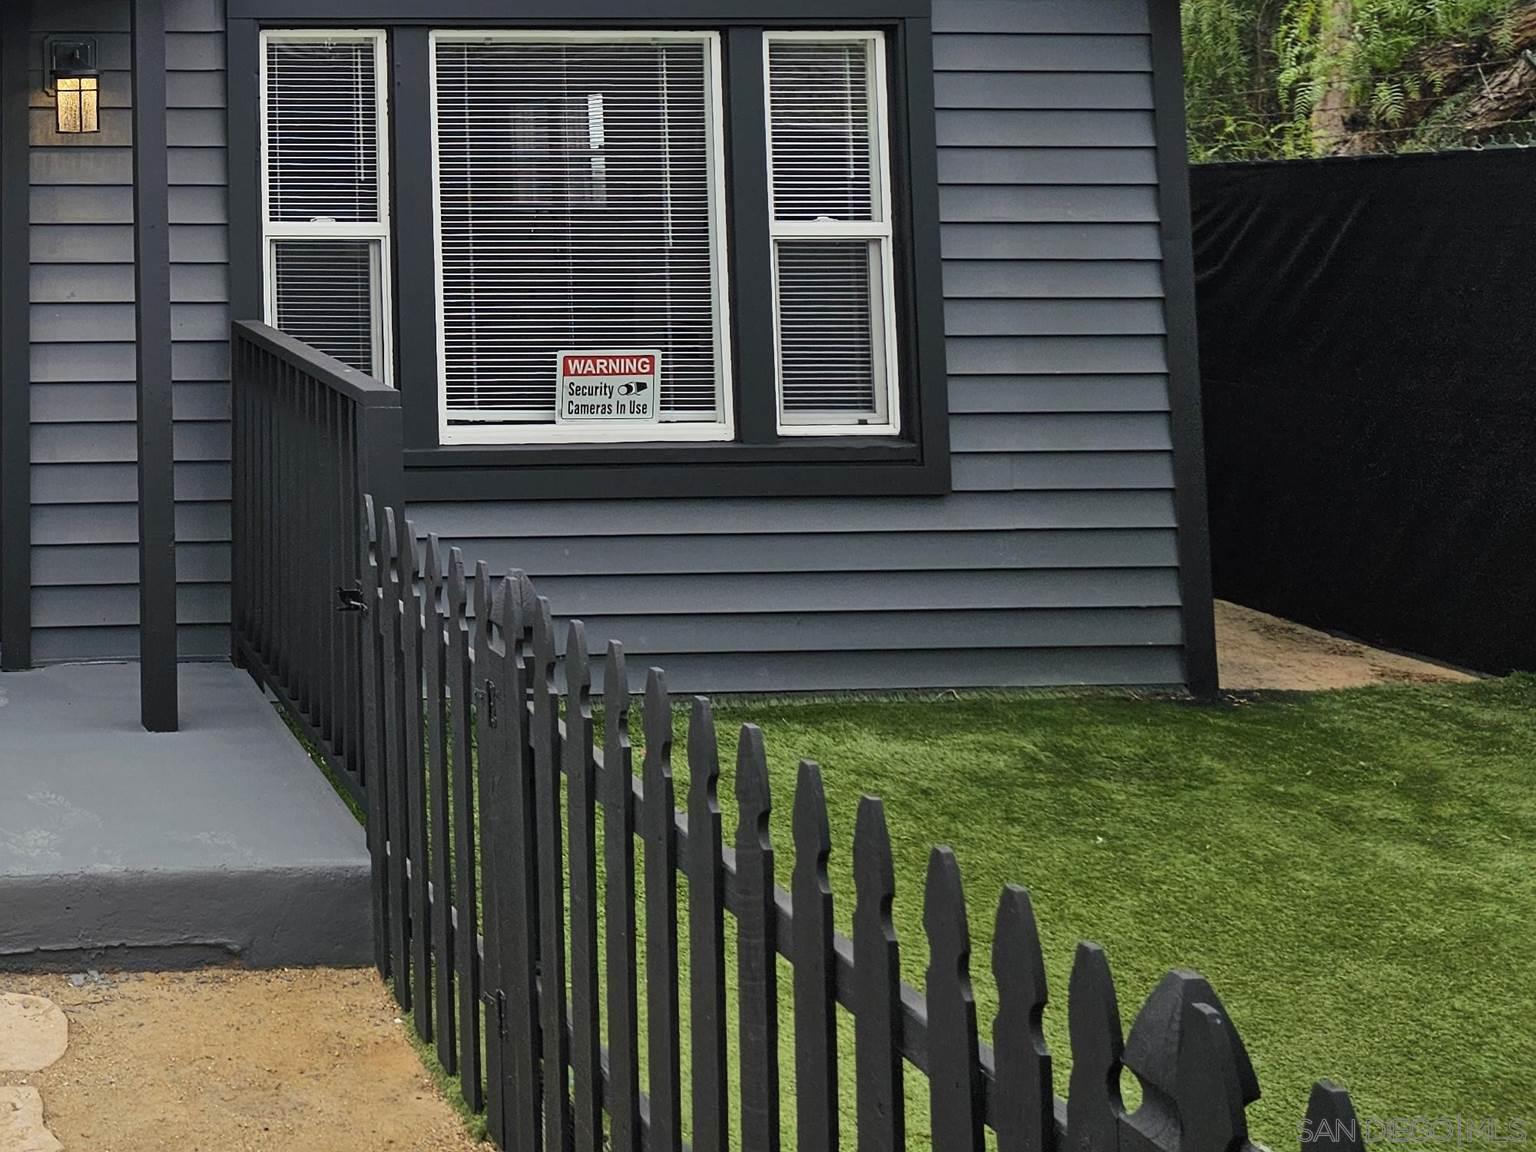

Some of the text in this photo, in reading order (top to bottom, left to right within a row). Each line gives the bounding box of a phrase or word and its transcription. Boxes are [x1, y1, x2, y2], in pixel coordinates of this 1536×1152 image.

[568, 358, 650, 374] WARNING
[568, 381, 615, 399] Security
[567, 399, 648, 415] Cameras In Use
